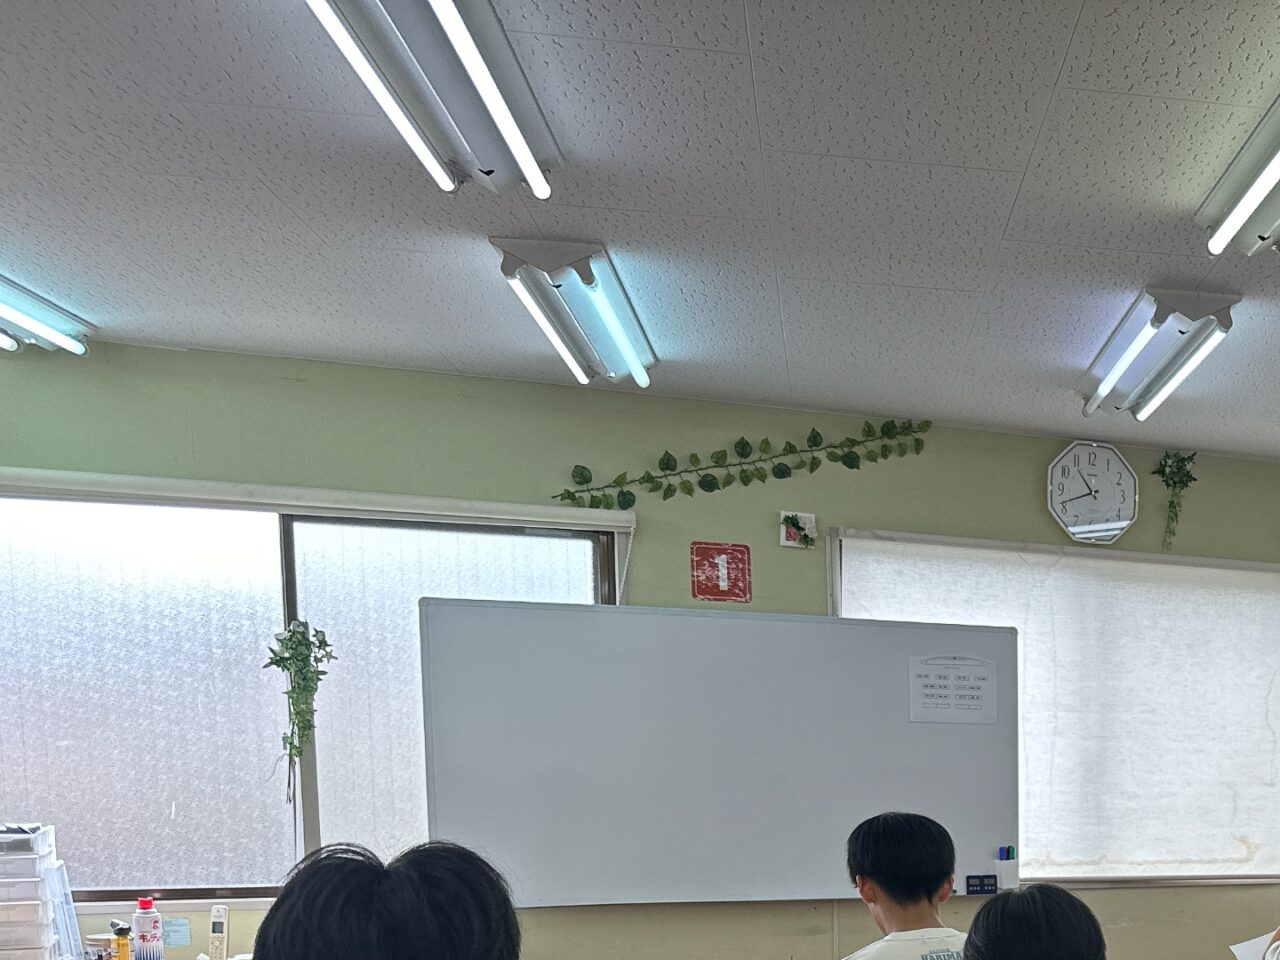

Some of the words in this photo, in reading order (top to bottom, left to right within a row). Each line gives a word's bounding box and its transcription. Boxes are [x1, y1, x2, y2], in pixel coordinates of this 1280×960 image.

[1073, 453, 1080, 468] 11
[1088, 451, 1097, 467] 12
[1061, 464, 1070, 479] 10
[1116, 471, 1122, 486] 2
[1057, 482, 1065, 497] 9
[1119, 489, 1126, 505] 3
[1060, 501, 1068, 515] 8
[1115, 507, 1121, 521] 4
[714, 554, 729, 591] 1
